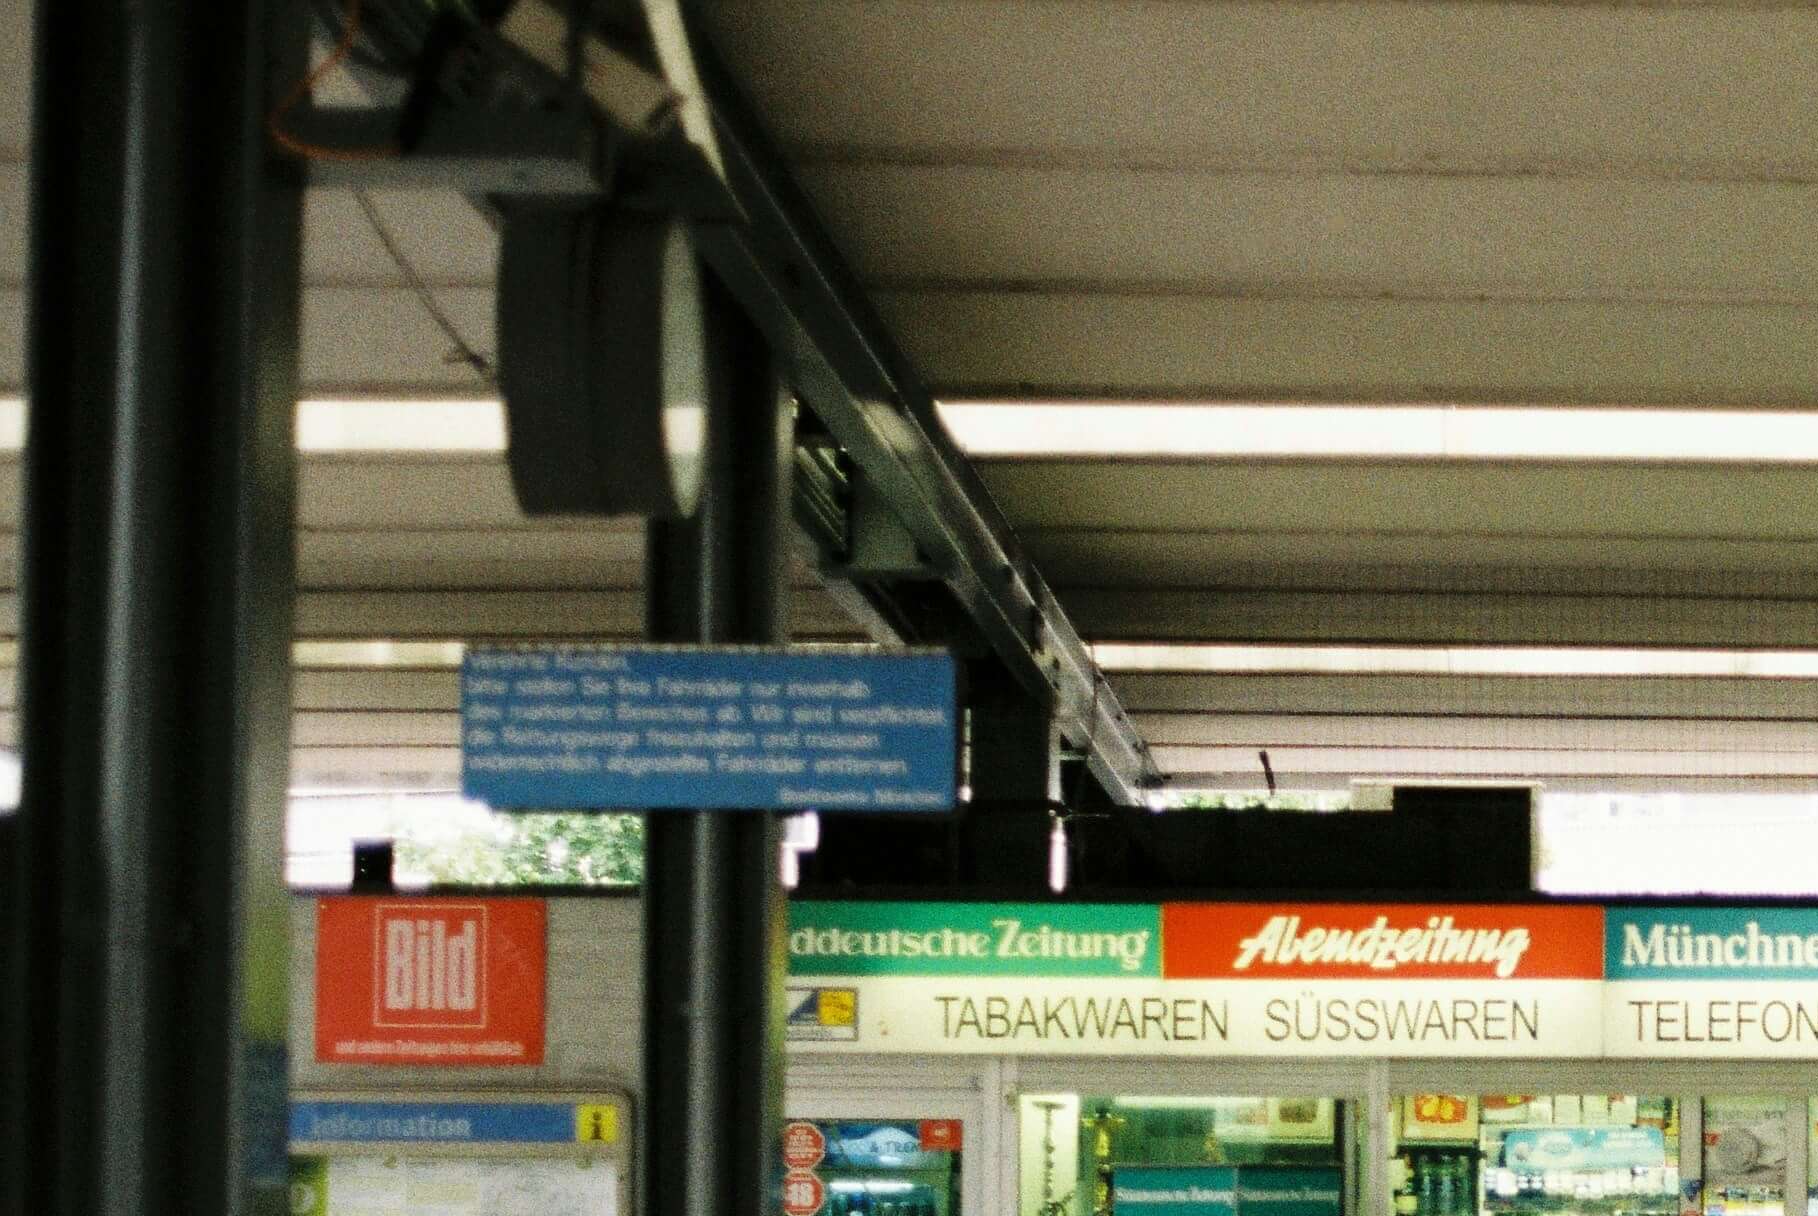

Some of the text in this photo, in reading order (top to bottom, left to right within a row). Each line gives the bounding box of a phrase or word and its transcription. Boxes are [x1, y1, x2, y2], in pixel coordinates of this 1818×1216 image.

[385, 919, 477, 1011] Bild
[991, 919, 1150, 971] Zeitung
[1232, 914, 1531, 980] Abendzeitung
[934, 996, 1229, 1042] TABAKWAREN
[1264, 990, 1540, 1042] SÜSSWAREN
